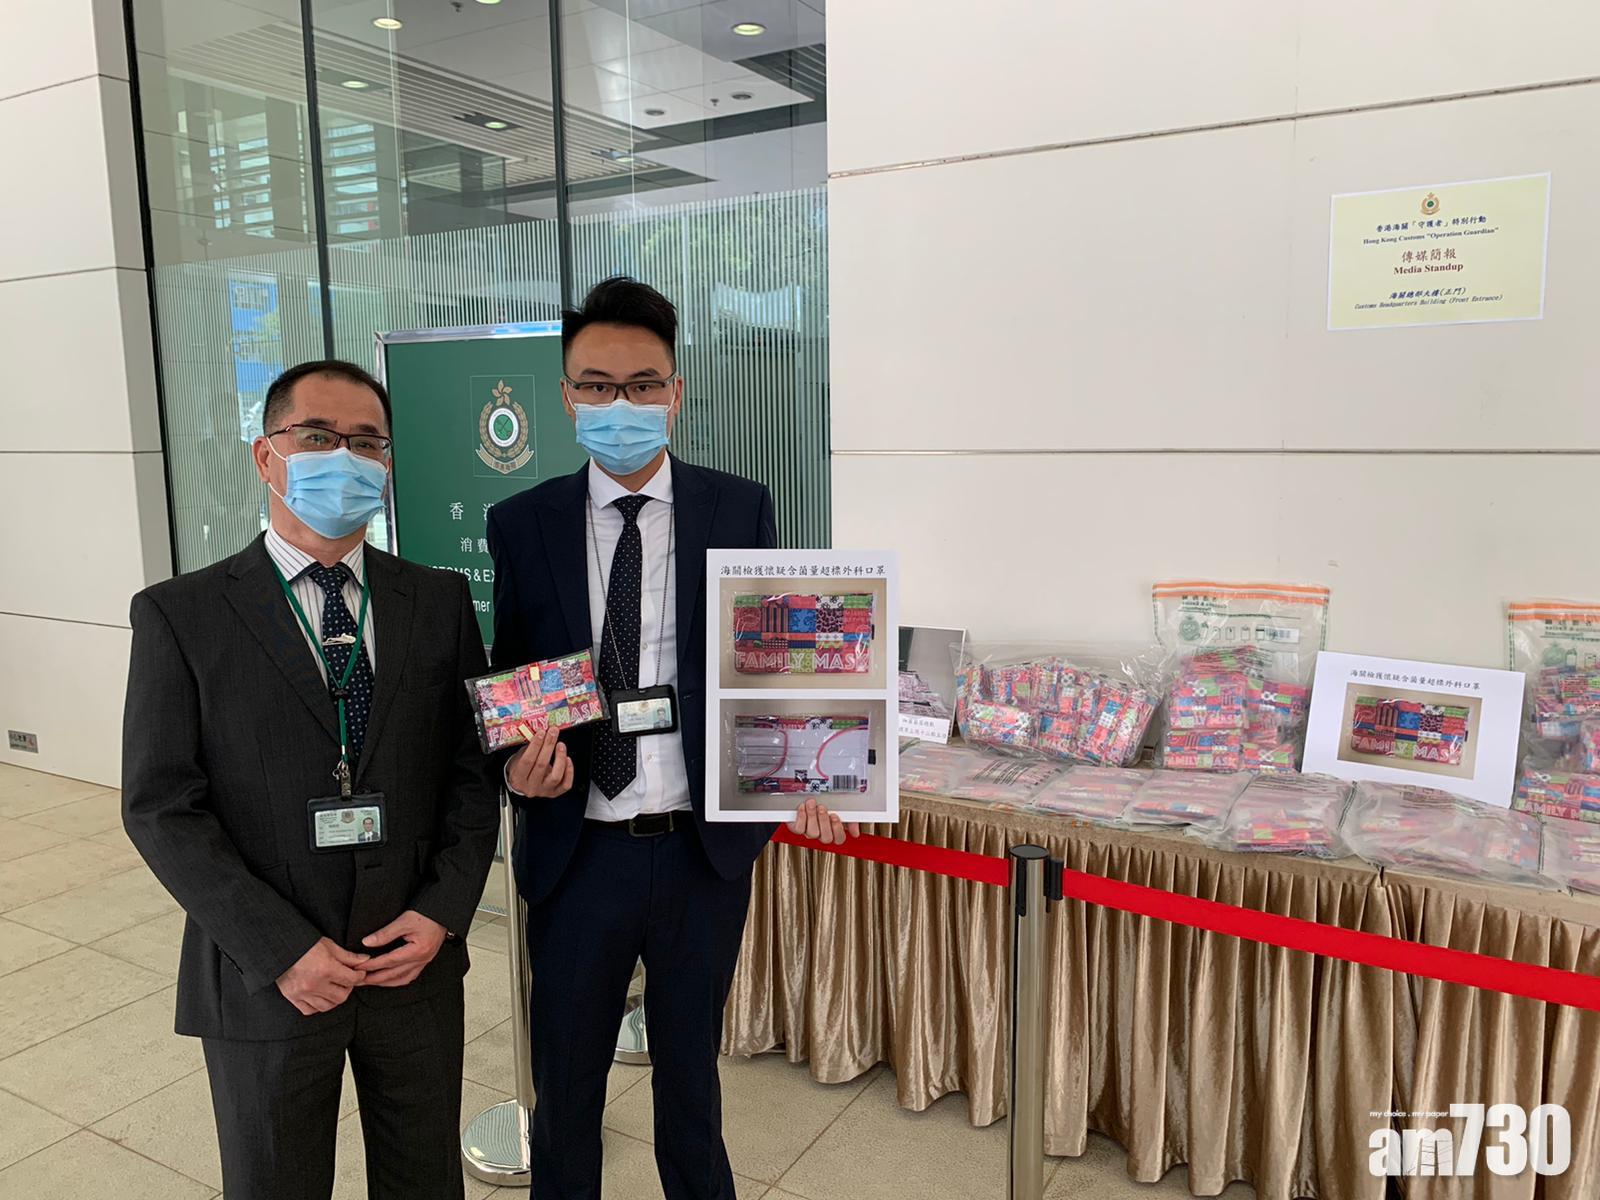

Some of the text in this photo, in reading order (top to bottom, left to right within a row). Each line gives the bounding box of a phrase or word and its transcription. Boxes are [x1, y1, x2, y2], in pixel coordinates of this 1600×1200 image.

[1402, 248, 1457, 263] 傳媒簡報
[1394, 263, 1464, 275] Media Standup
[734, 651, 806, 668] FAMILY
[555, 701, 601, 725] MASK
